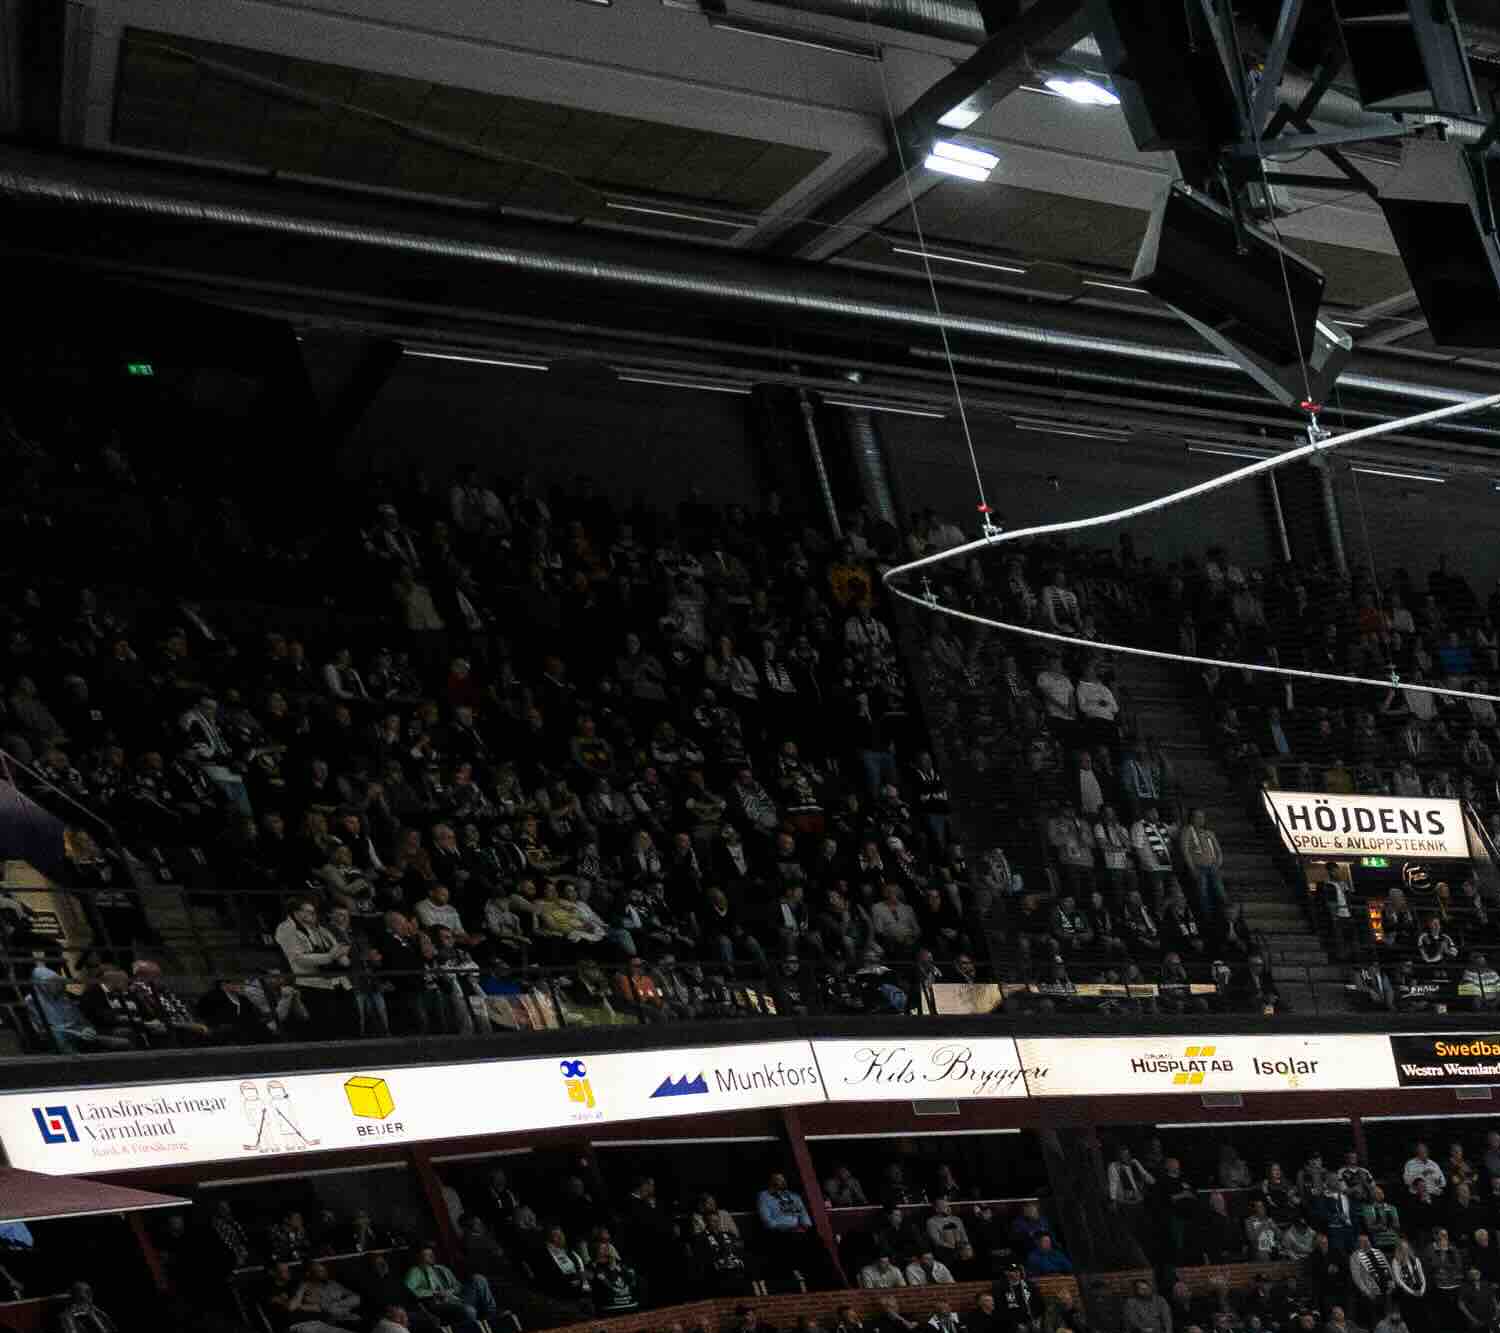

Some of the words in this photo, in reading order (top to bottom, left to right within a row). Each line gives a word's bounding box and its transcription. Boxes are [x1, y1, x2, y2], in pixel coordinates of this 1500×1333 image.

[1286, 799, 1447, 836] HÖJDENS
[1294, 835, 1332, 850] SPOL-
[1333, 836, 1345, 850] &
[1345, 836, 1448, 852] AVLOPPSTEKNIK
[1130, 1058, 1210, 1075] HUSPLAT
[1210, 1057, 1234, 1072] AB
[1253, 1057, 1320, 1076] Isolar
[1401, 1063, 1443, 1077] Westra
[714, 1062, 820, 1093] Munkfors
[75, 1093, 229, 1122] Länsförsäkringar
[83, 1116, 178, 1143] Värmland
[356, 1121, 405, 1137] BEIJER
